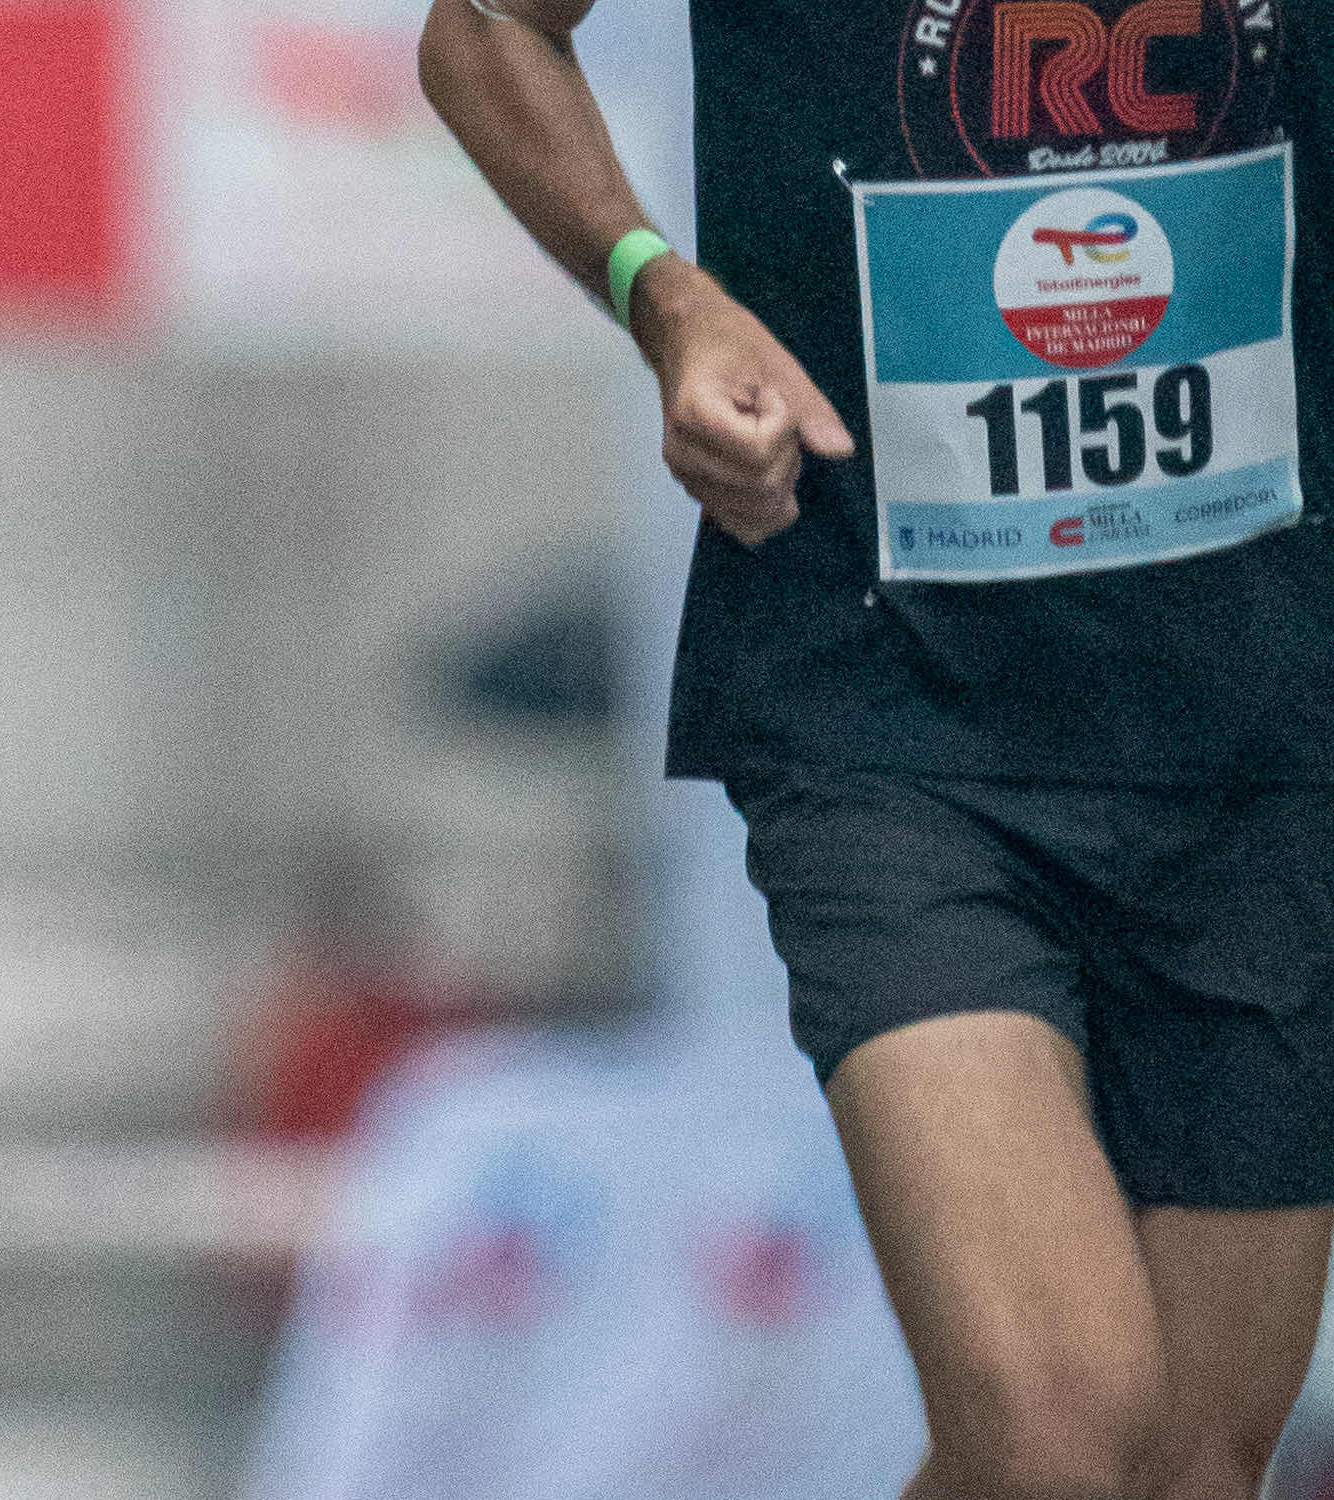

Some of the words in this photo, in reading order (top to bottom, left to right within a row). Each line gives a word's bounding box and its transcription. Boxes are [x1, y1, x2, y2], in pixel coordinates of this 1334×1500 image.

[991, 0, 1203, 138] RC
[1035, 273, 1142, 293] TotalEnergies
[1062, 307, 1113, 323] MILLA
[1025, 316, 1150, 342] INTERNACIONAL
[1047, 341, 1068, 356] DE
[1072, 334, 1133, 354] MADRID
[967, 362, 1214, 498] 1159
[928, 526, 1023, 549] MADRID
